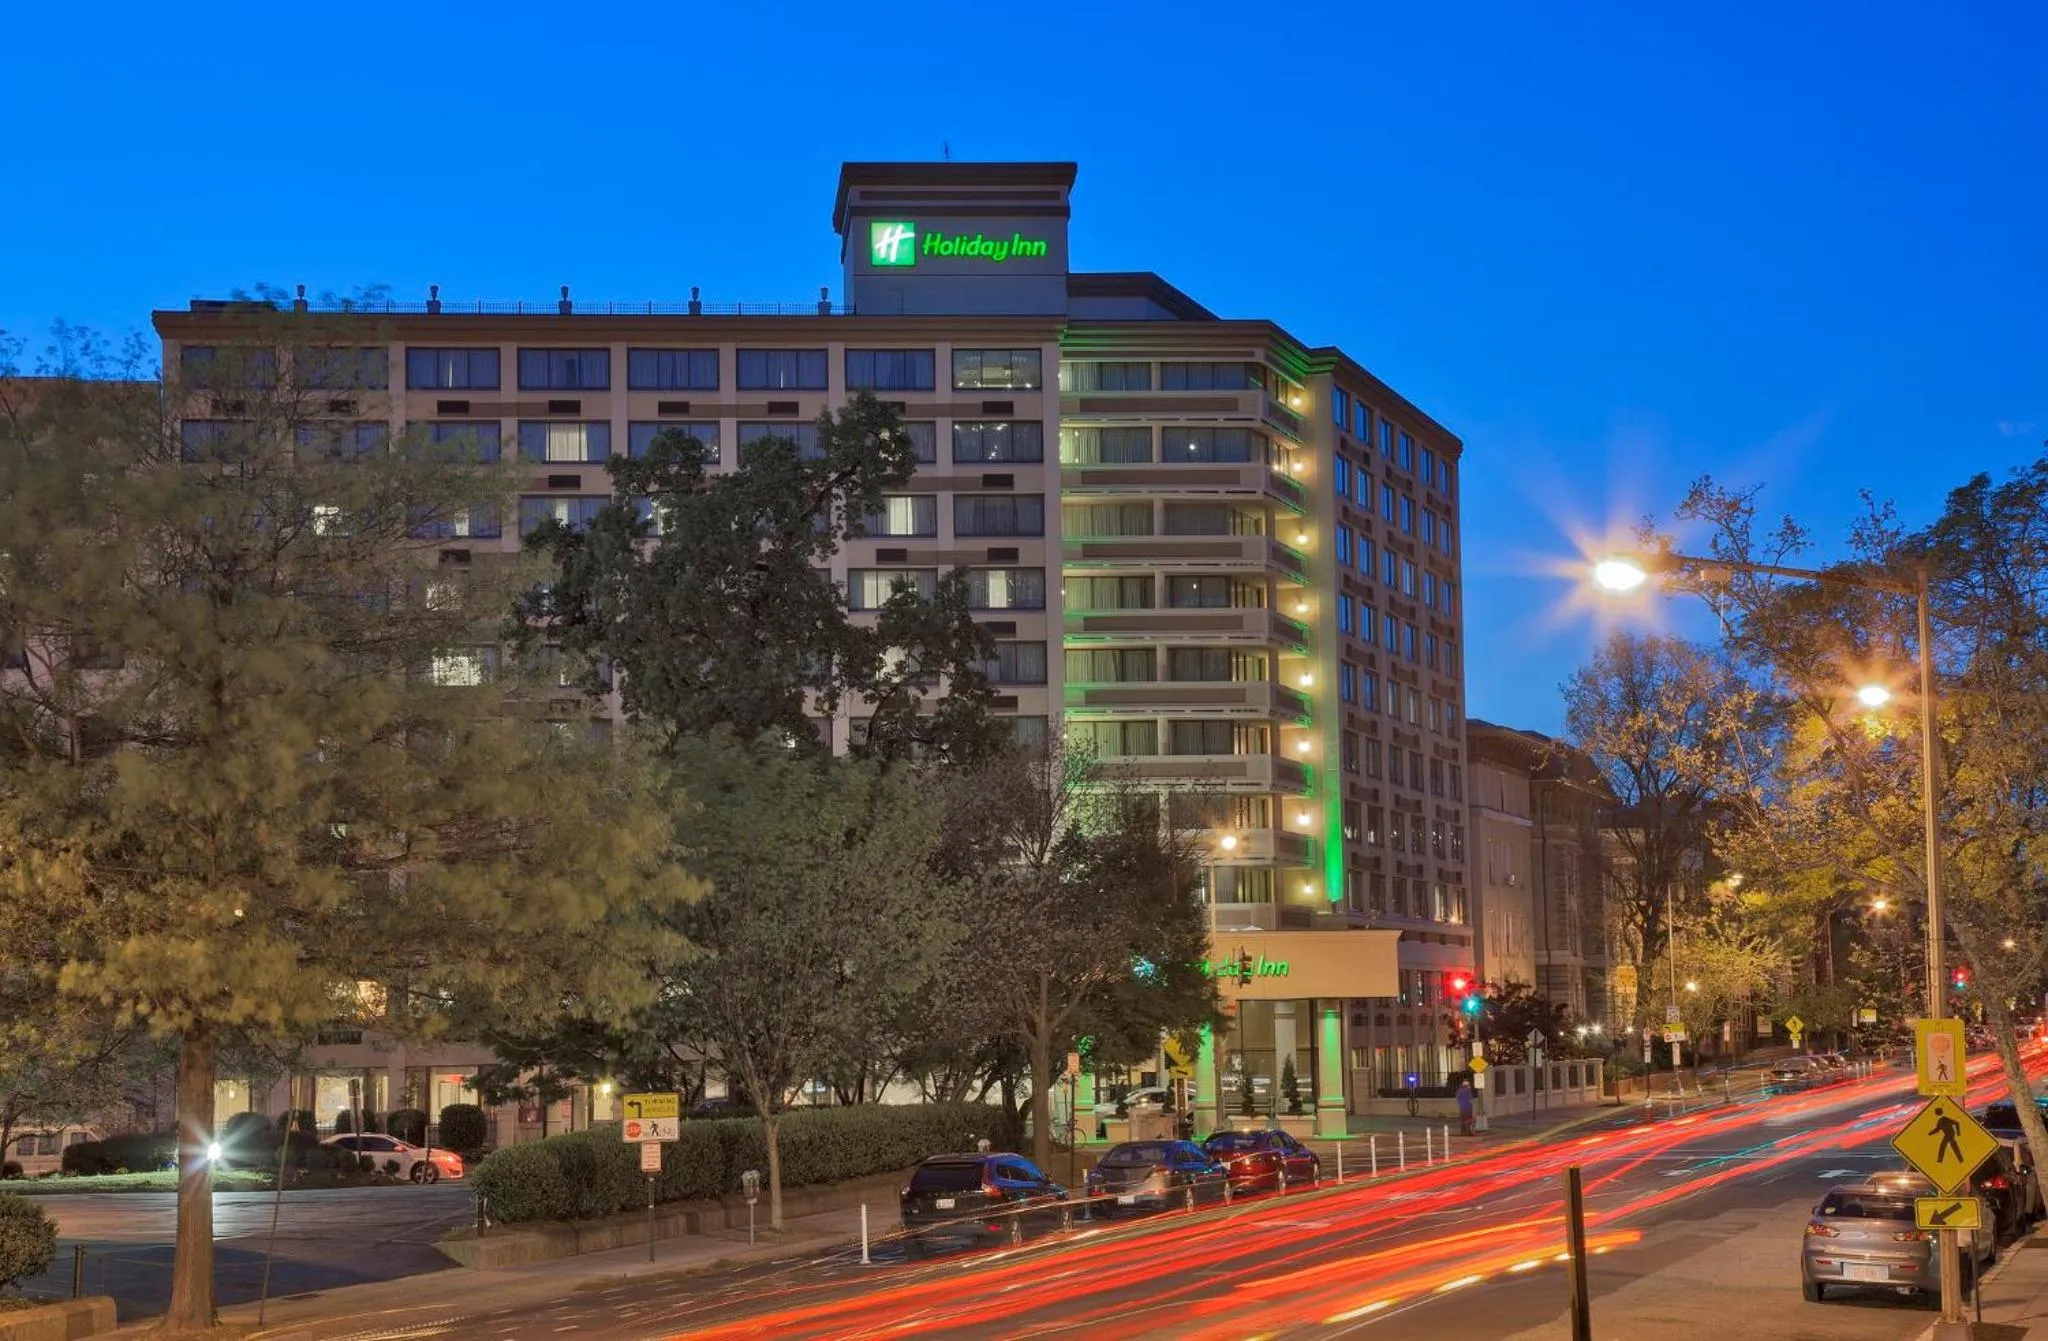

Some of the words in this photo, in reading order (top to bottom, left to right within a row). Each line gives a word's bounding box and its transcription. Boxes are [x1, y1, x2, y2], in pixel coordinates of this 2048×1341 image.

[922, 232, 1009, 262] Holiday
[1011, 232, 1047, 256] Inn
[1257, 954, 1290, 976] Inn
